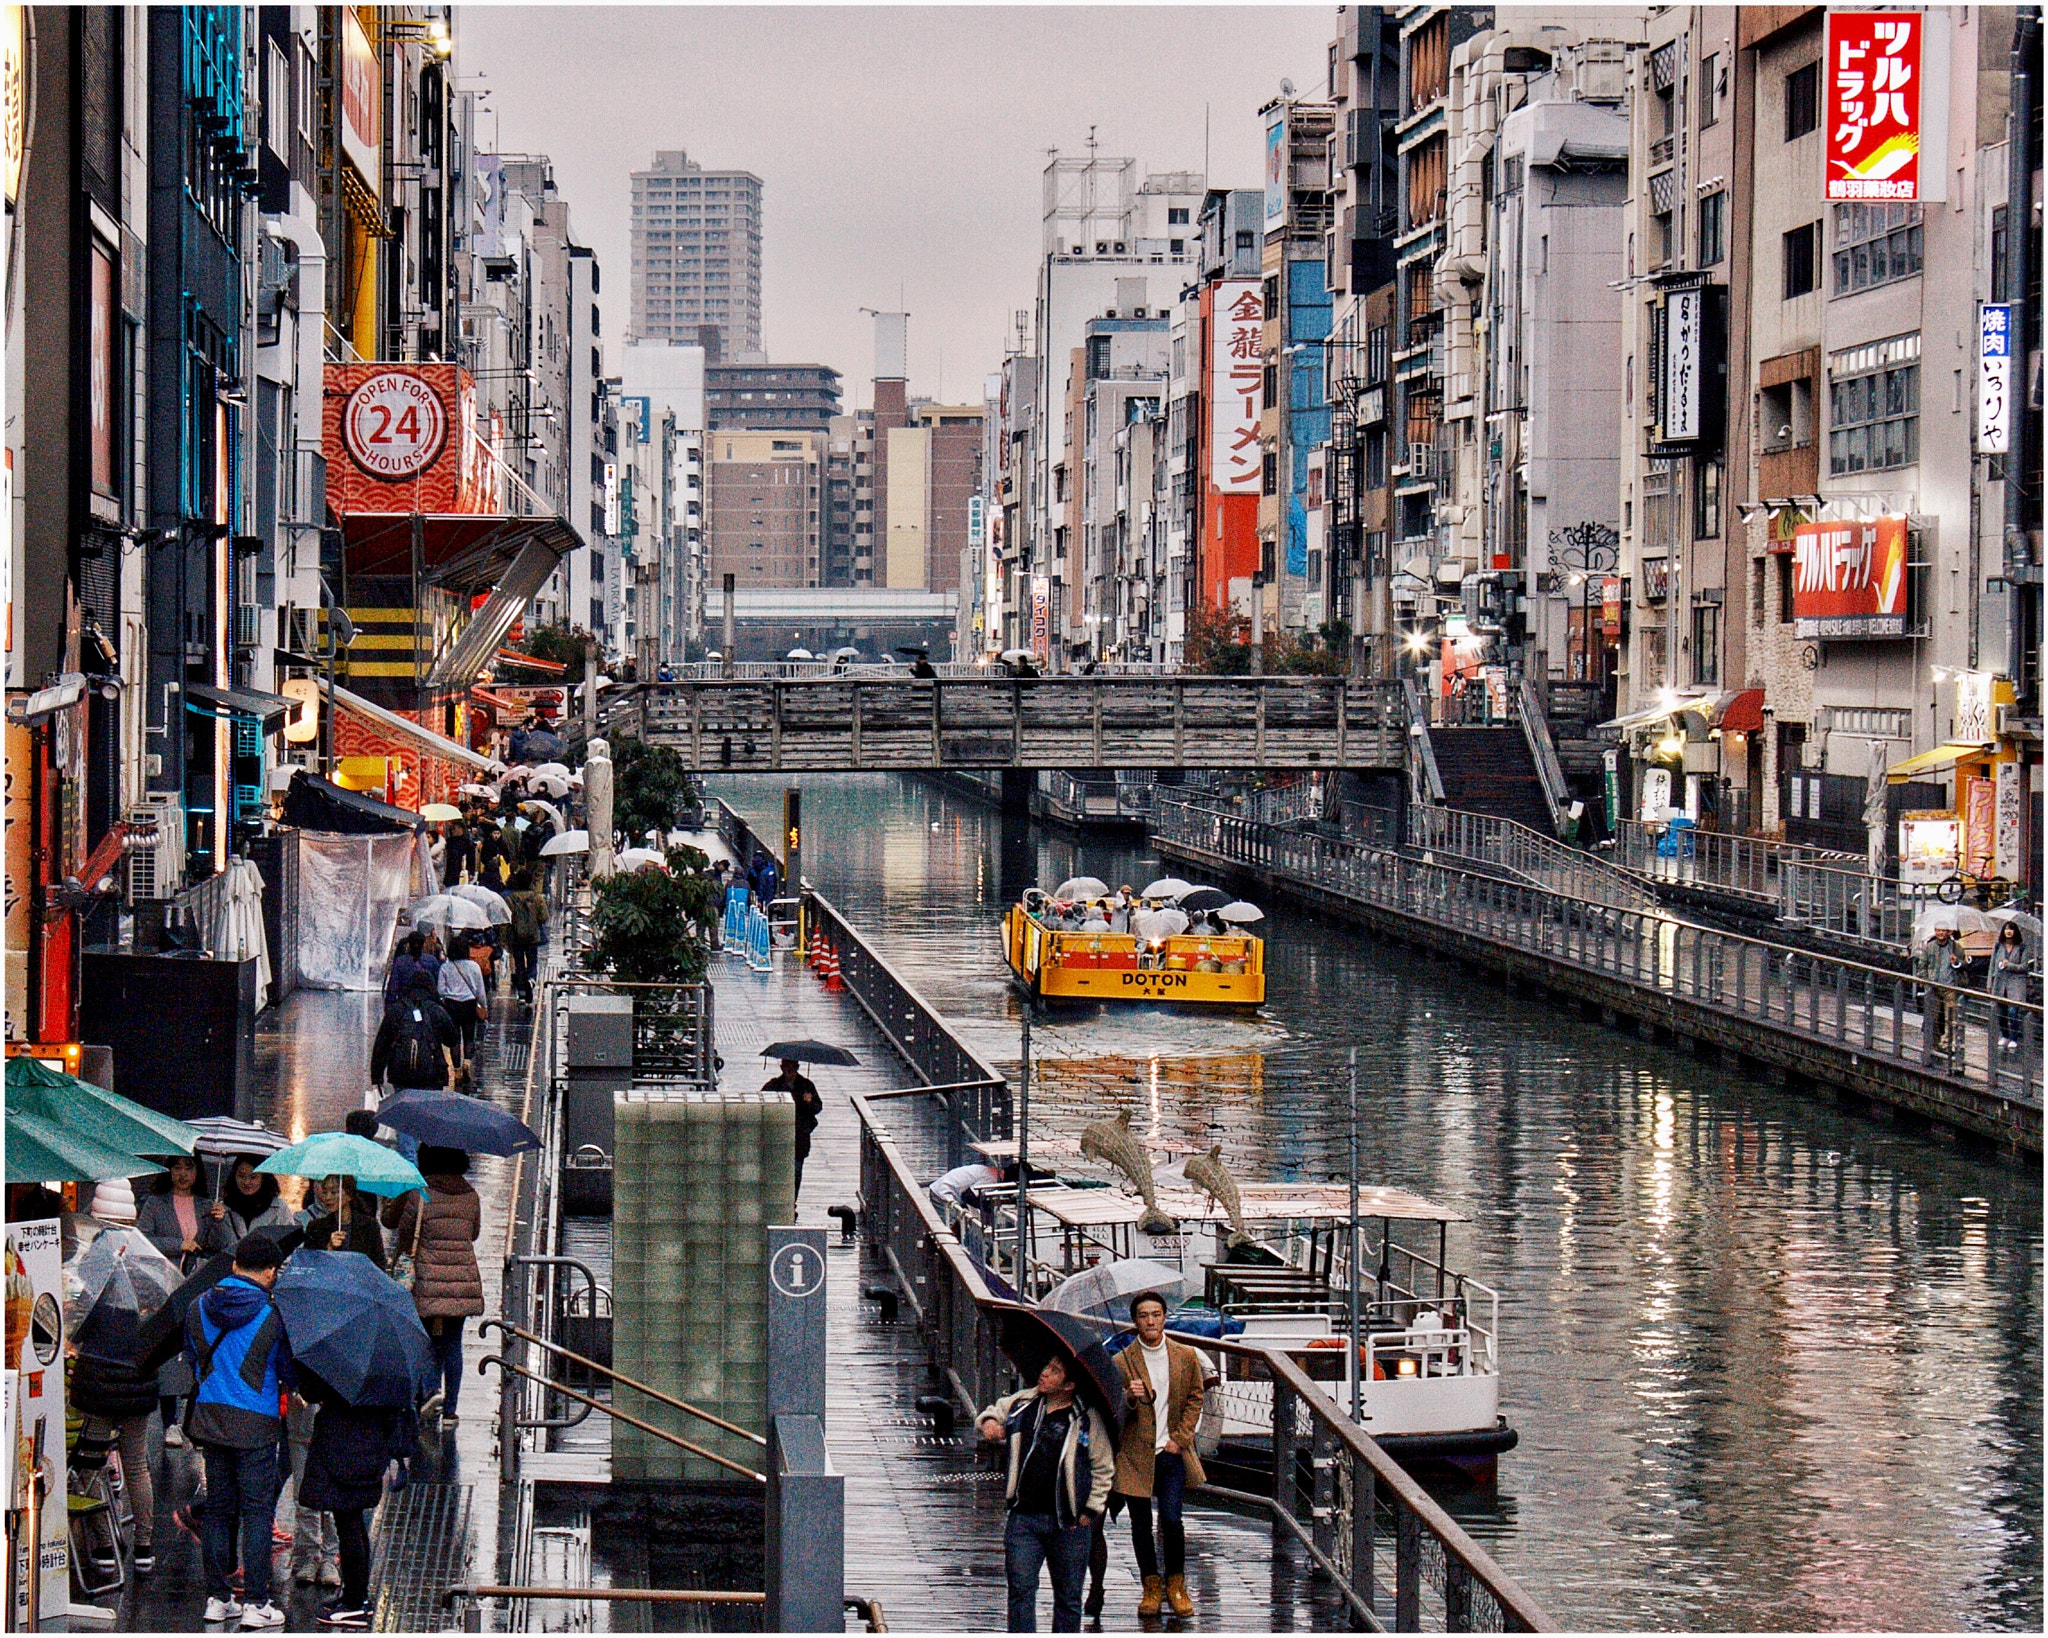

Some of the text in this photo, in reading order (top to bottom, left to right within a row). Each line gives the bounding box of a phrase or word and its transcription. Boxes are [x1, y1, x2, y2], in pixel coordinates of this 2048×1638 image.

[1835, 40, 1870, 154] ドラッグ
[1870, 22, 1911, 126] ツルハ
[358, 378, 430, 405] OPEN FOR
[1227, 290, 1262, 484] 金龍ラーメン
[1983, 309, 2006, 448] 焼肉 いろりや
[369, 405, 422, 444] 24
[366, 450, 423, 471] HOURS
[1796, 526, 1877, 593] ツルハドラッグ
[1122, 973, 1187, 986] DOTON
